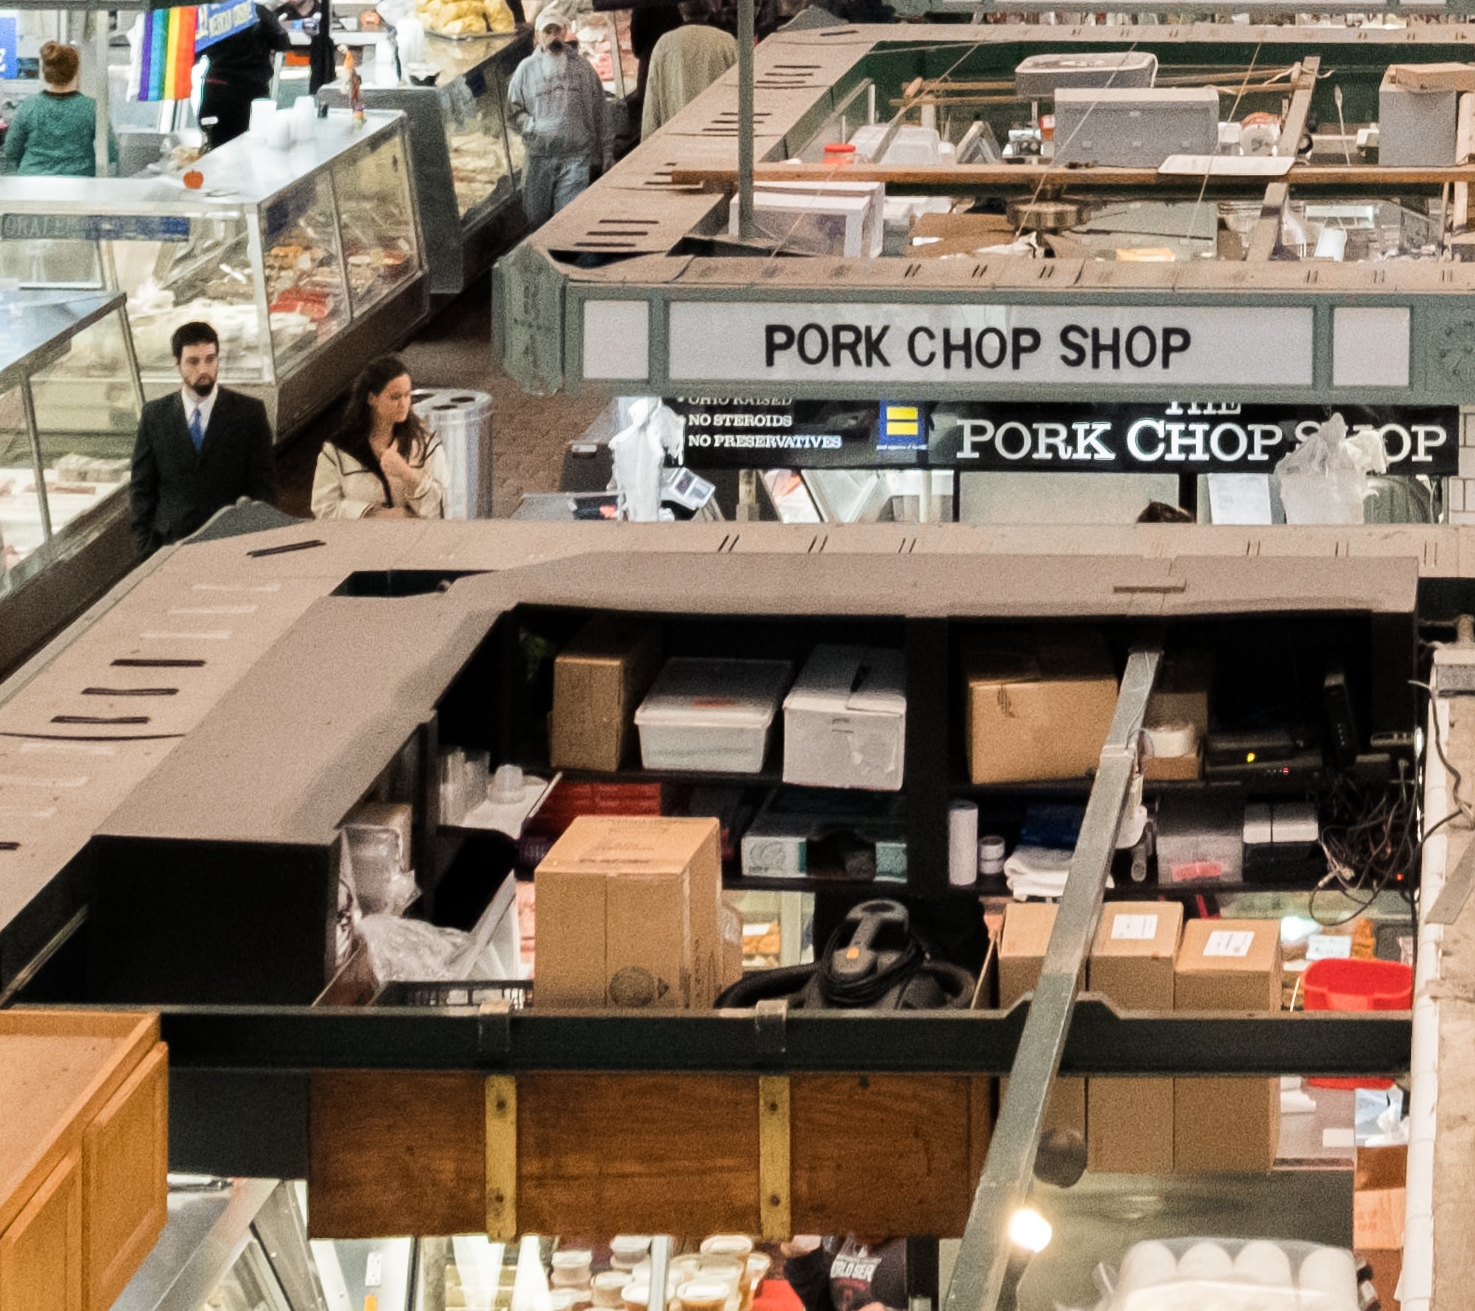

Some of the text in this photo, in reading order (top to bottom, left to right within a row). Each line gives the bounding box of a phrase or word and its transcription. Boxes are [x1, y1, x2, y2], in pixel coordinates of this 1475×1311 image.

[765, 323, 1192, 370] PORK CHOP SHOP
[688, 396, 793, 406] OHIO RAISED
[687, 414, 793, 427] NO STEROIDS
[687, 434, 843, 449] NO PRESERVATIVES
[956, 417, 1448, 462] PORK CHOP SOP
